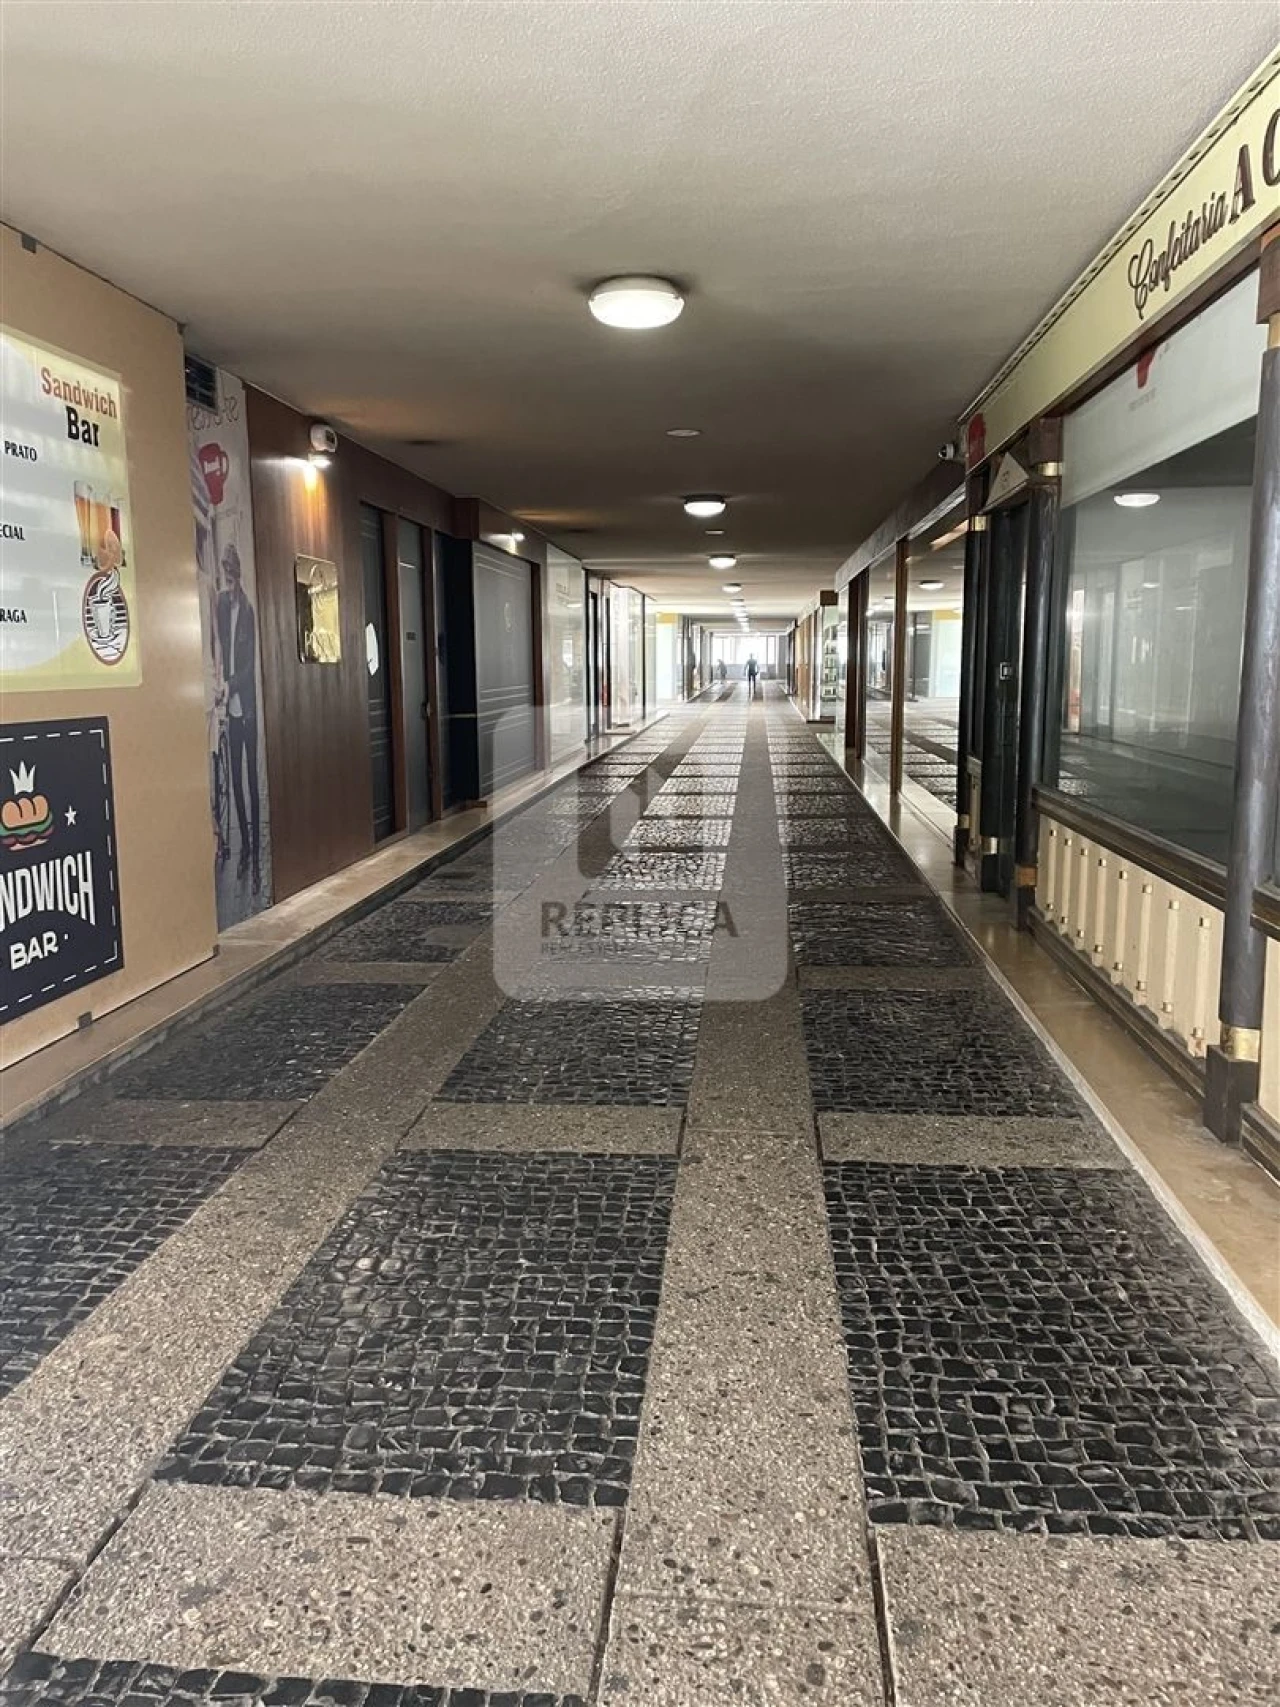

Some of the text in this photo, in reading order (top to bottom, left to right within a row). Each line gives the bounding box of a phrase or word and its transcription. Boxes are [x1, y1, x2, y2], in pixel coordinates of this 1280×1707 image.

[1128, 191, 1228, 319] Confeitaria
[1229, 143, 1256, 225] A
[40, 366, 118, 420] Sandwich
[65, 405, 100, 447] Bar
[4, 440, 38, 462] PRATO
